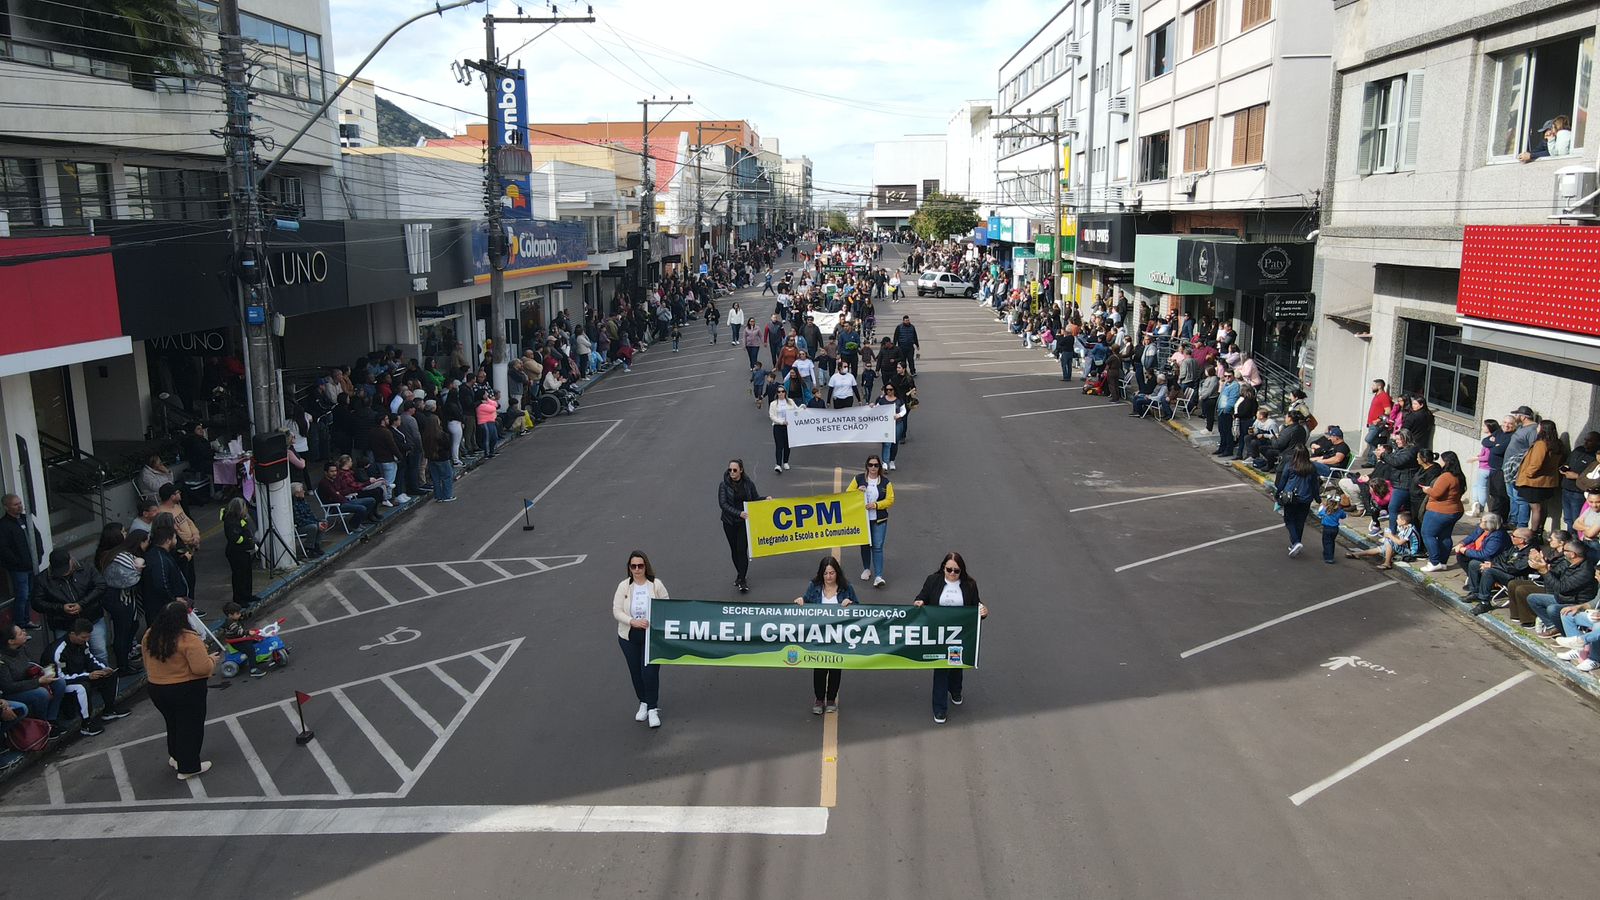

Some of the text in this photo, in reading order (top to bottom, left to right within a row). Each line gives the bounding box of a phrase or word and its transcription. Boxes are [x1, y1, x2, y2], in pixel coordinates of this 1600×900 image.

[519, 233, 558, 258] Colombo
[281, 250, 328, 285] UNO
[180, 332, 224, 350] UNO
[794, 415, 889, 426] VAMOS PLANTAR SONHOS
[816, 423, 868, 432] NESTE CHÃO?
[772, 500, 843, 530] CPM
[757, 534, 789, 546] Integrando
[795, 531, 814, 540] Escola
[825, 526, 860, 537] Comunidade
[722, 606, 907, 619] SECRETARIA MUNICIPAL DE EDUCAÇÃO
[664, 619, 963, 649] E.M.E.I CRIANÇA FELIZ
[803, 654, 844, 664] OSÓRIO
